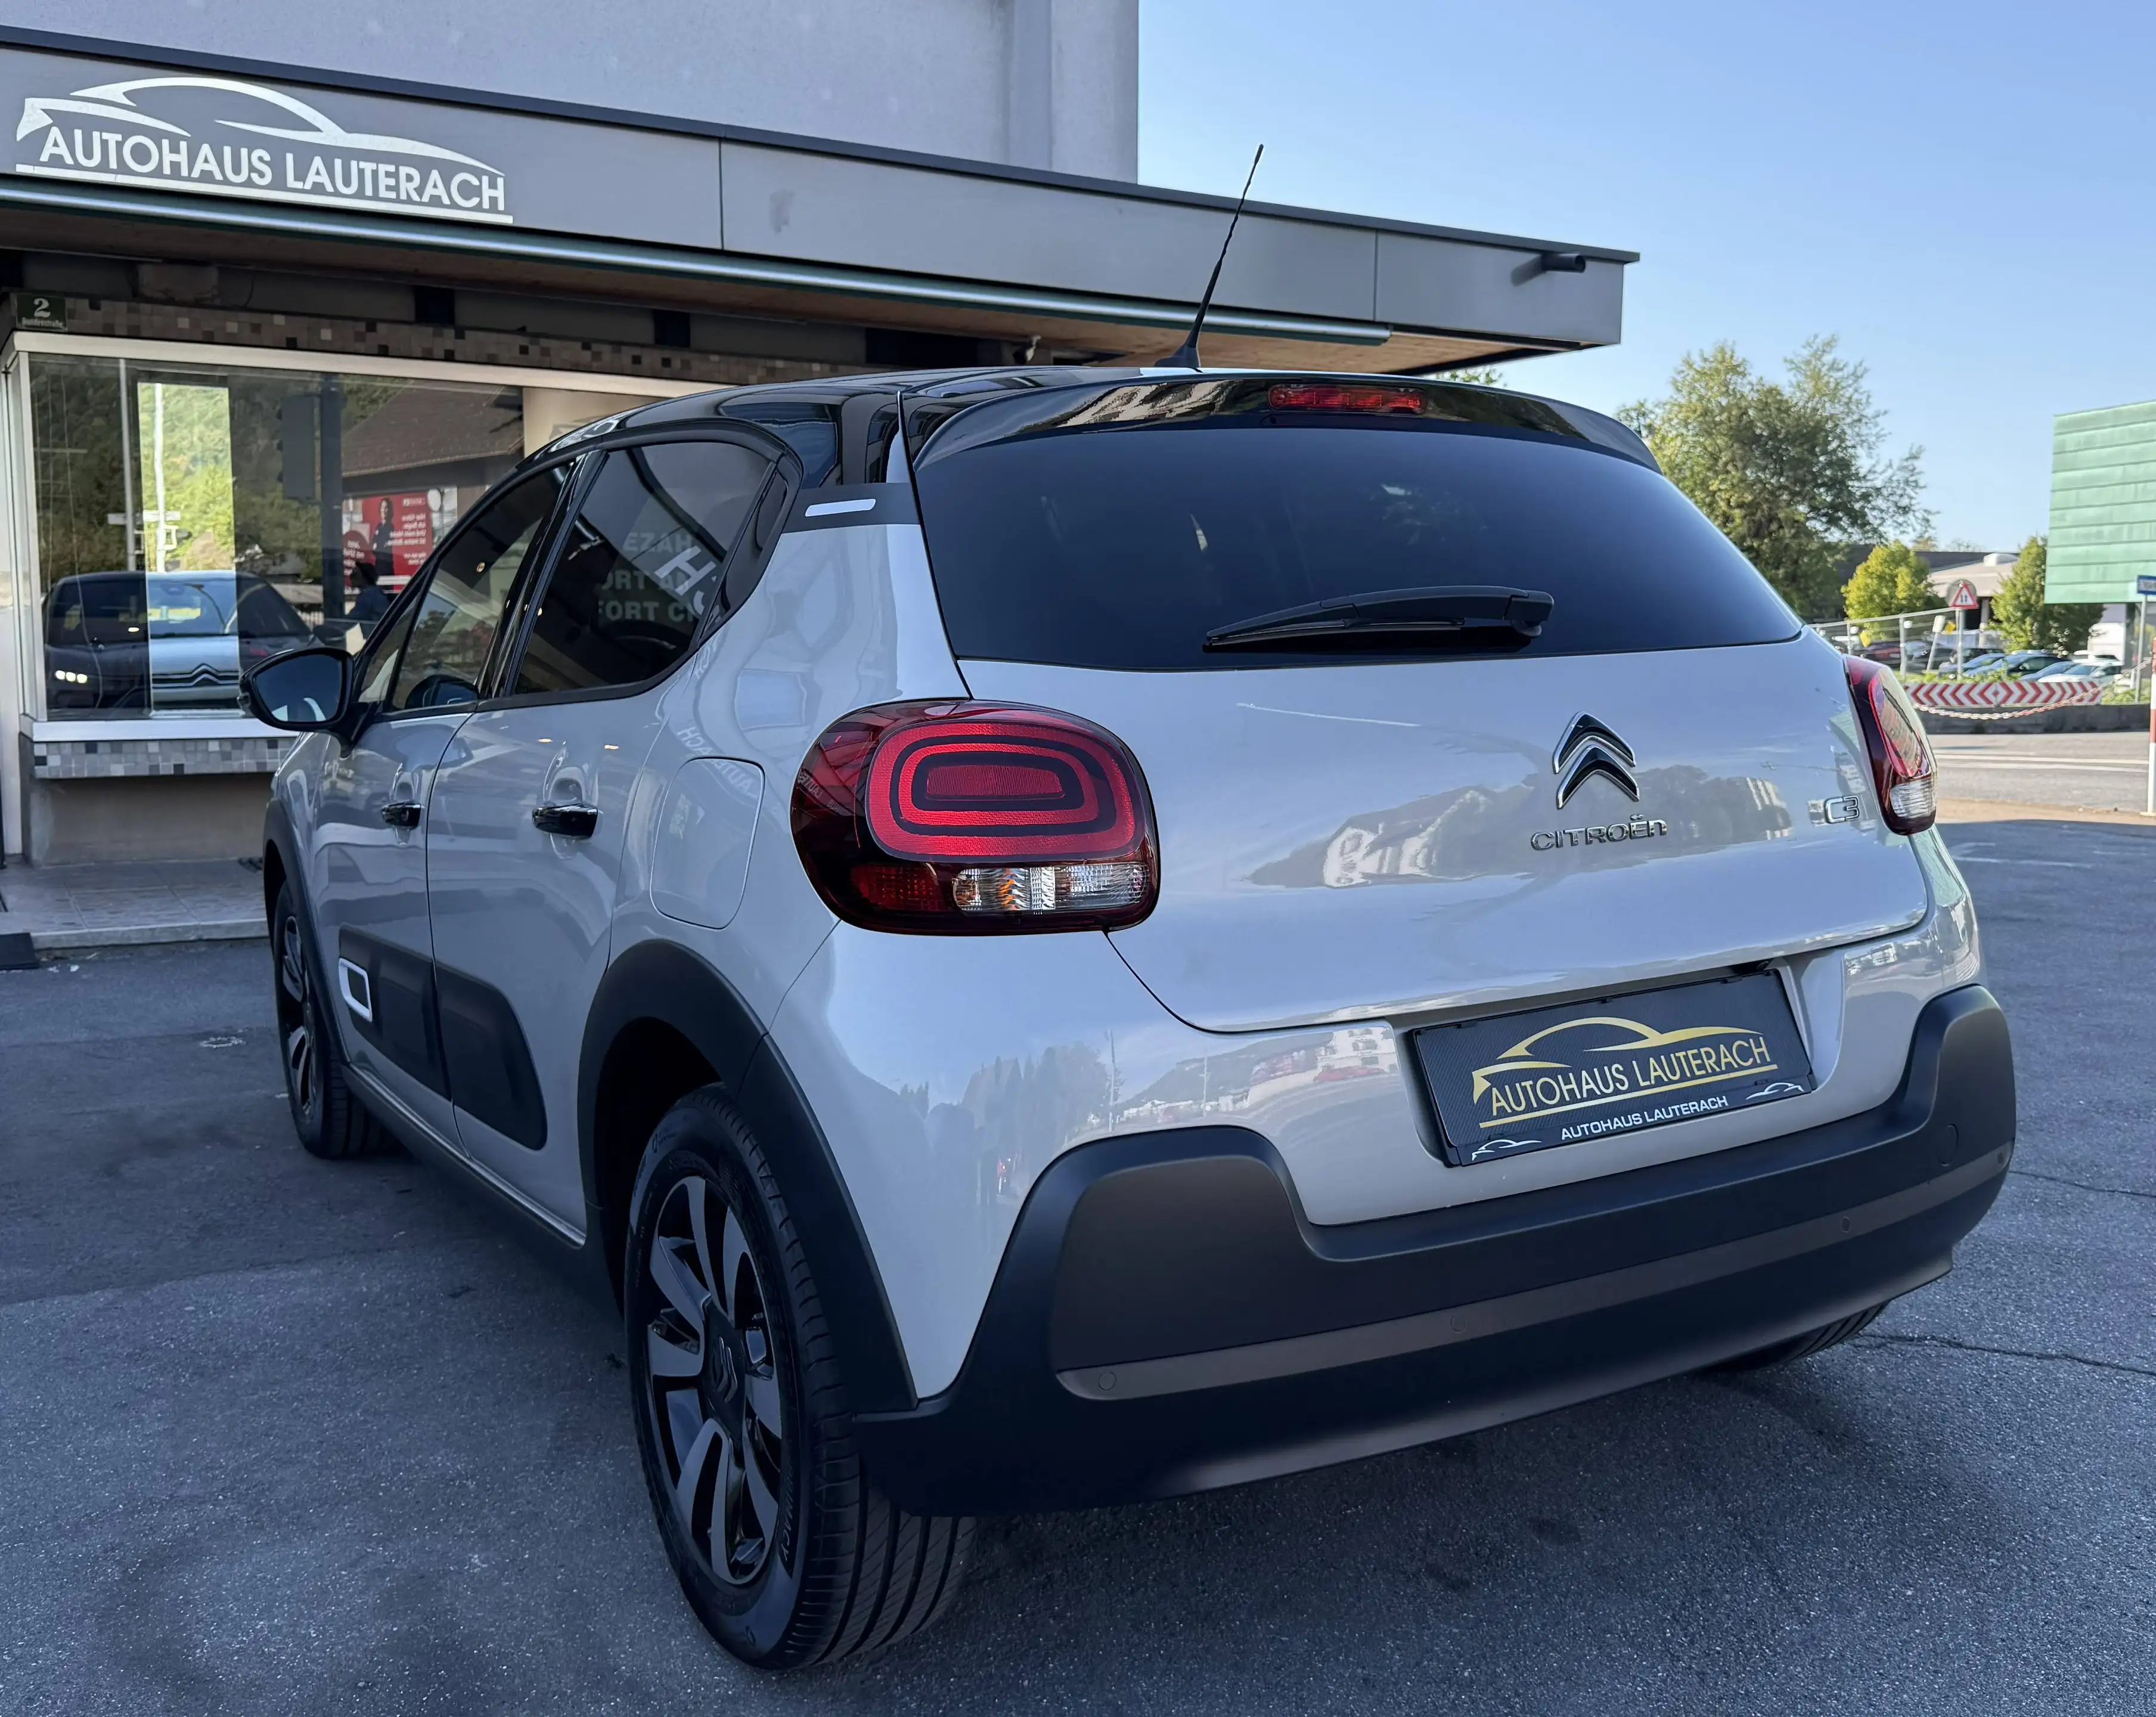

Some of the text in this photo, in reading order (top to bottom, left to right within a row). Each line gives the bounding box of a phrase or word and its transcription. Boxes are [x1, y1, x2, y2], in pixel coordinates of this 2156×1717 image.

[39, 126, 505, 211] AUTOHAUS LAUTERACH
[33, 297, 51, 318] 2
[1824, 795, 1860, 825] C3
[1530, 814, 1667, 851] CITROËN
[1492, 1036, 1771, 1116] AUTOHAUS LAUTERACH
[1561, 1096, 1729, 1140] AUTOHAUS LAUTERACH
